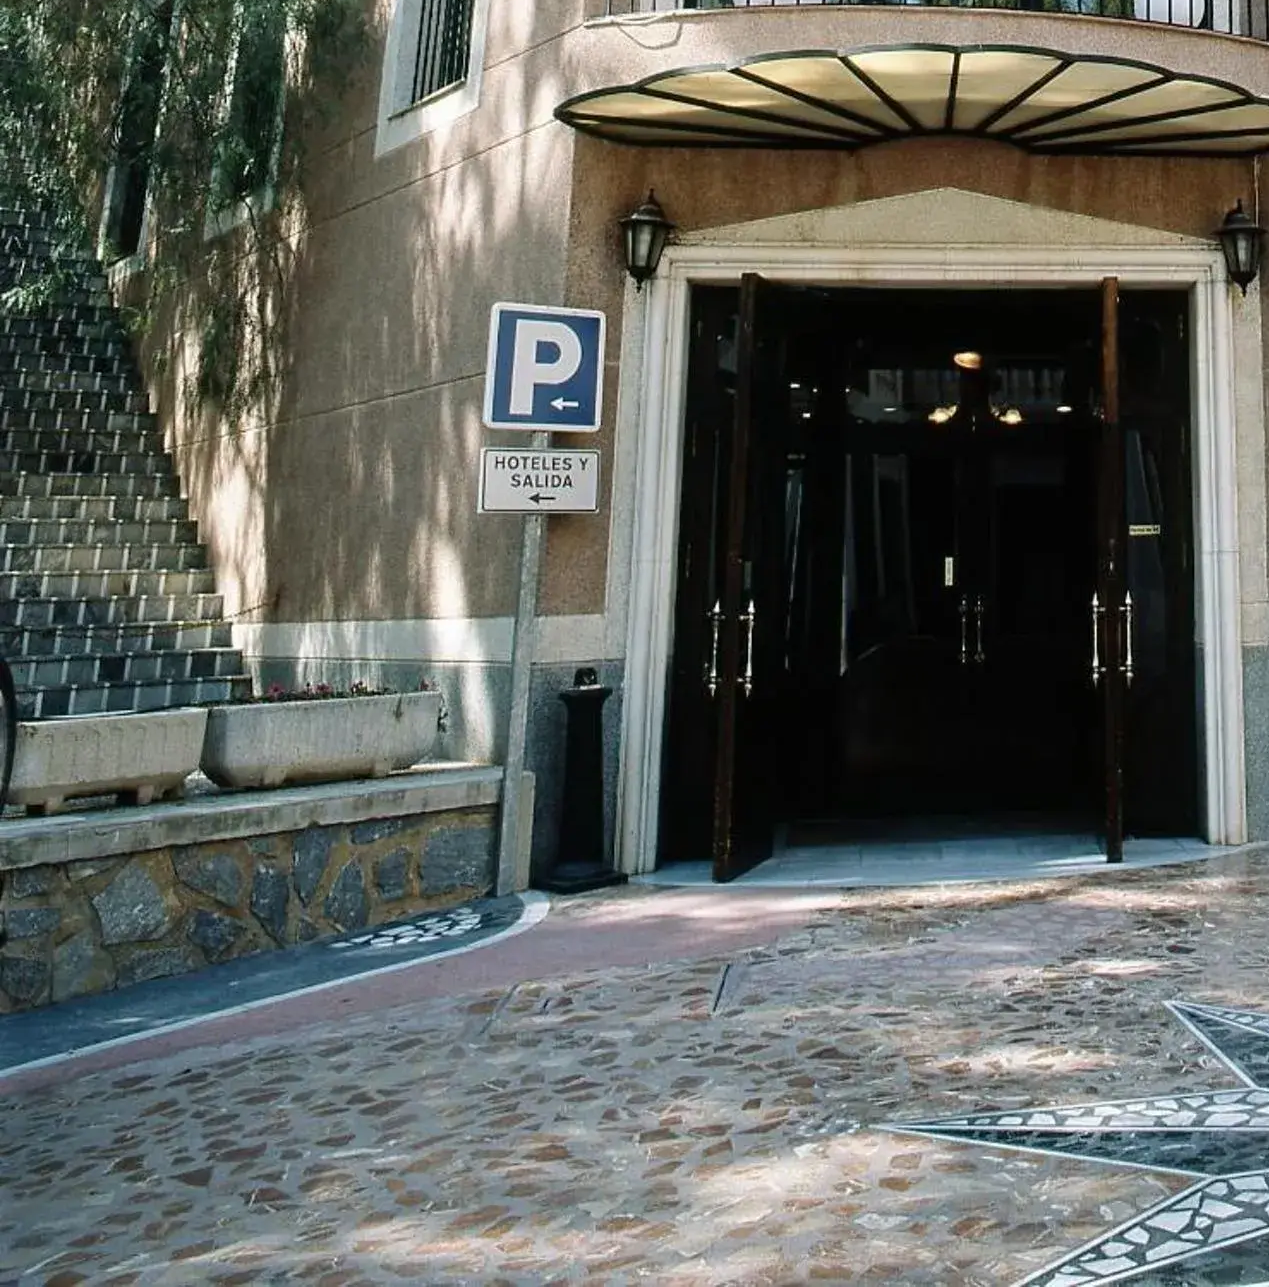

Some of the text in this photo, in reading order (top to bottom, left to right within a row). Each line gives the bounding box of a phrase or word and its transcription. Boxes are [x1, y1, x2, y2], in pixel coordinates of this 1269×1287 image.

[509, 318, 582, 415] P
[494, 455, 590, 471] HOTELES Y
[510, 474, 573, 488] SALIDA
